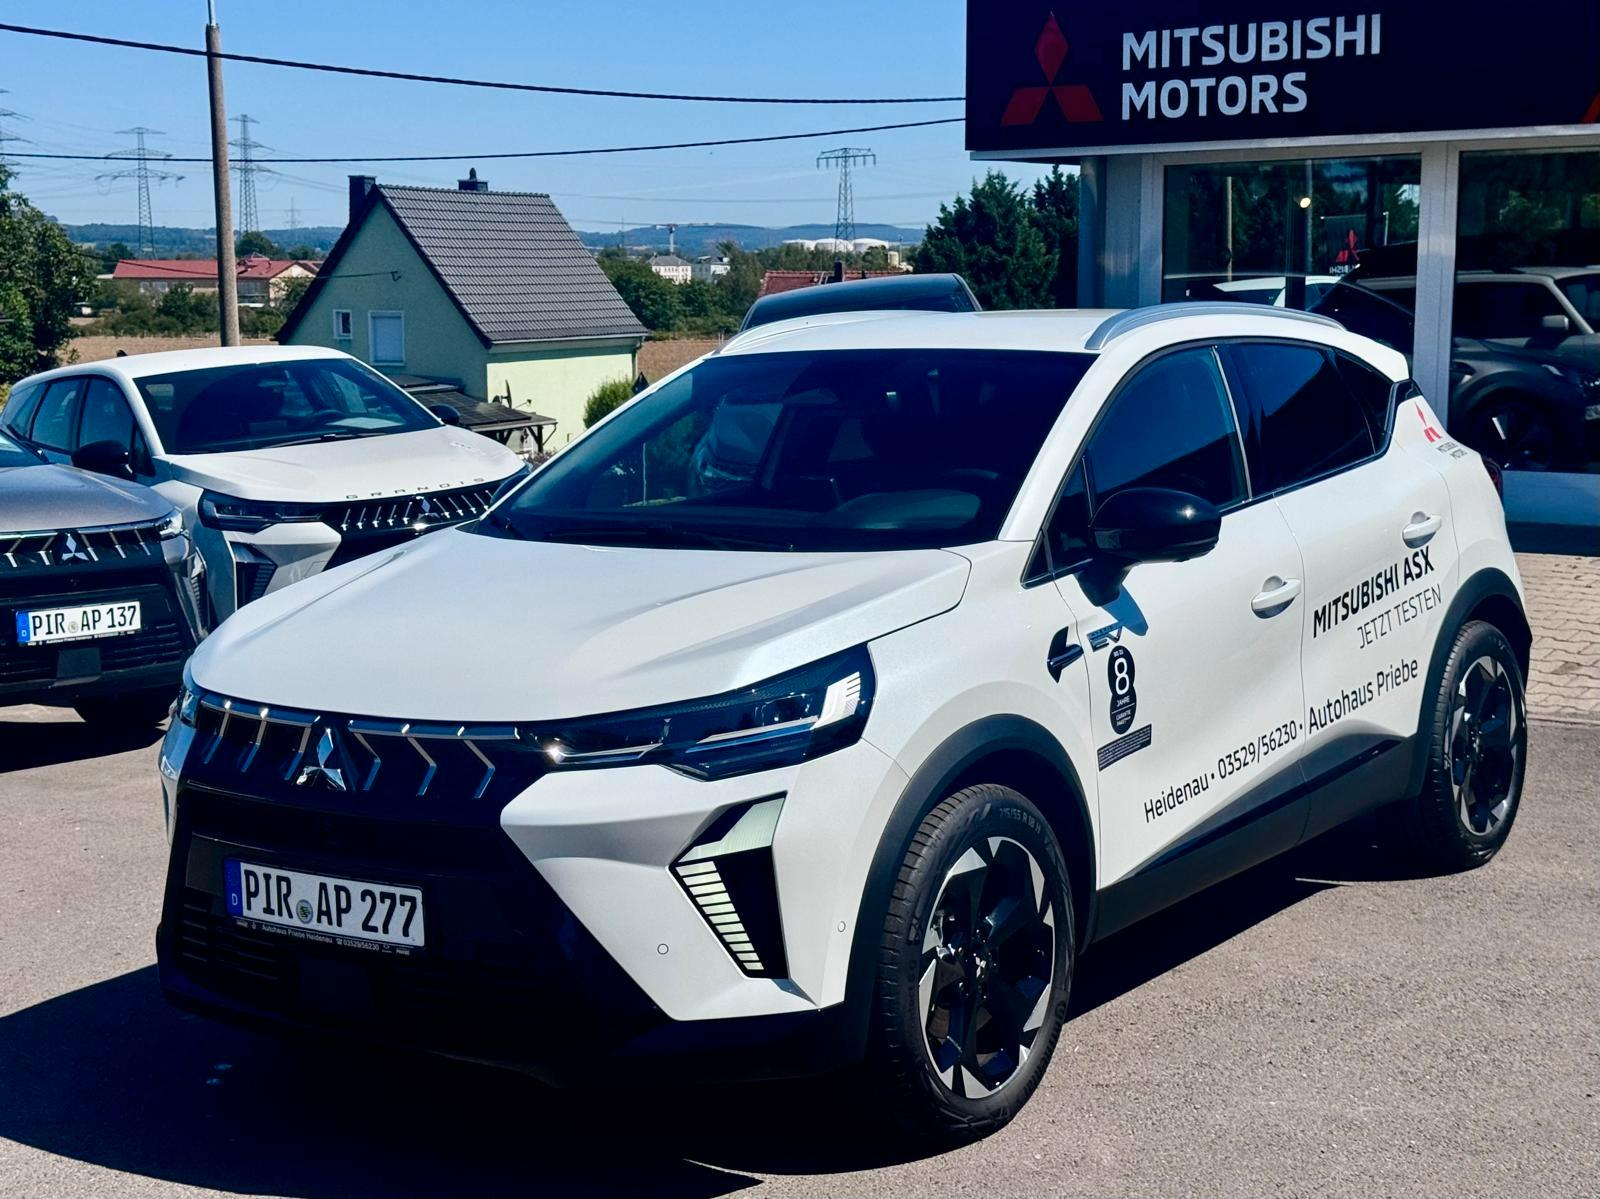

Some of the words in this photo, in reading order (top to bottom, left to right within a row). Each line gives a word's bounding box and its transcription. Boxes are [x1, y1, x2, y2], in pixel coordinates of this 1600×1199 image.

[1121, 14, 1382, 71] MITSUBISHI
[1121, 72, 1308, 120] MOTORS
[31, 612, 66, 637] PIR
[80, 609, 102, 631] AP
[106, 605, 137, 629] 137
[1313, 563, 1400, 639] MITSUBISHI
[1403, 545, 1435, 586] ASX
[1357, 609, 1392, 649] JETZT
[1393, 583, 1442, 626] TESTEN
[1114, 657, 1130, 695] 8
[1144, 776, 1210, 824] Heidenau
[1216, 720, 1298, 781] 03529/56230
[1309, 690, 1374, 735] Autohaus
[1376, 657, 1420, 698] Priebe
[243, 869, 294, 919] PIR
[316, 882, 352, 928] AP
[360, 888, 417, 938] 277
